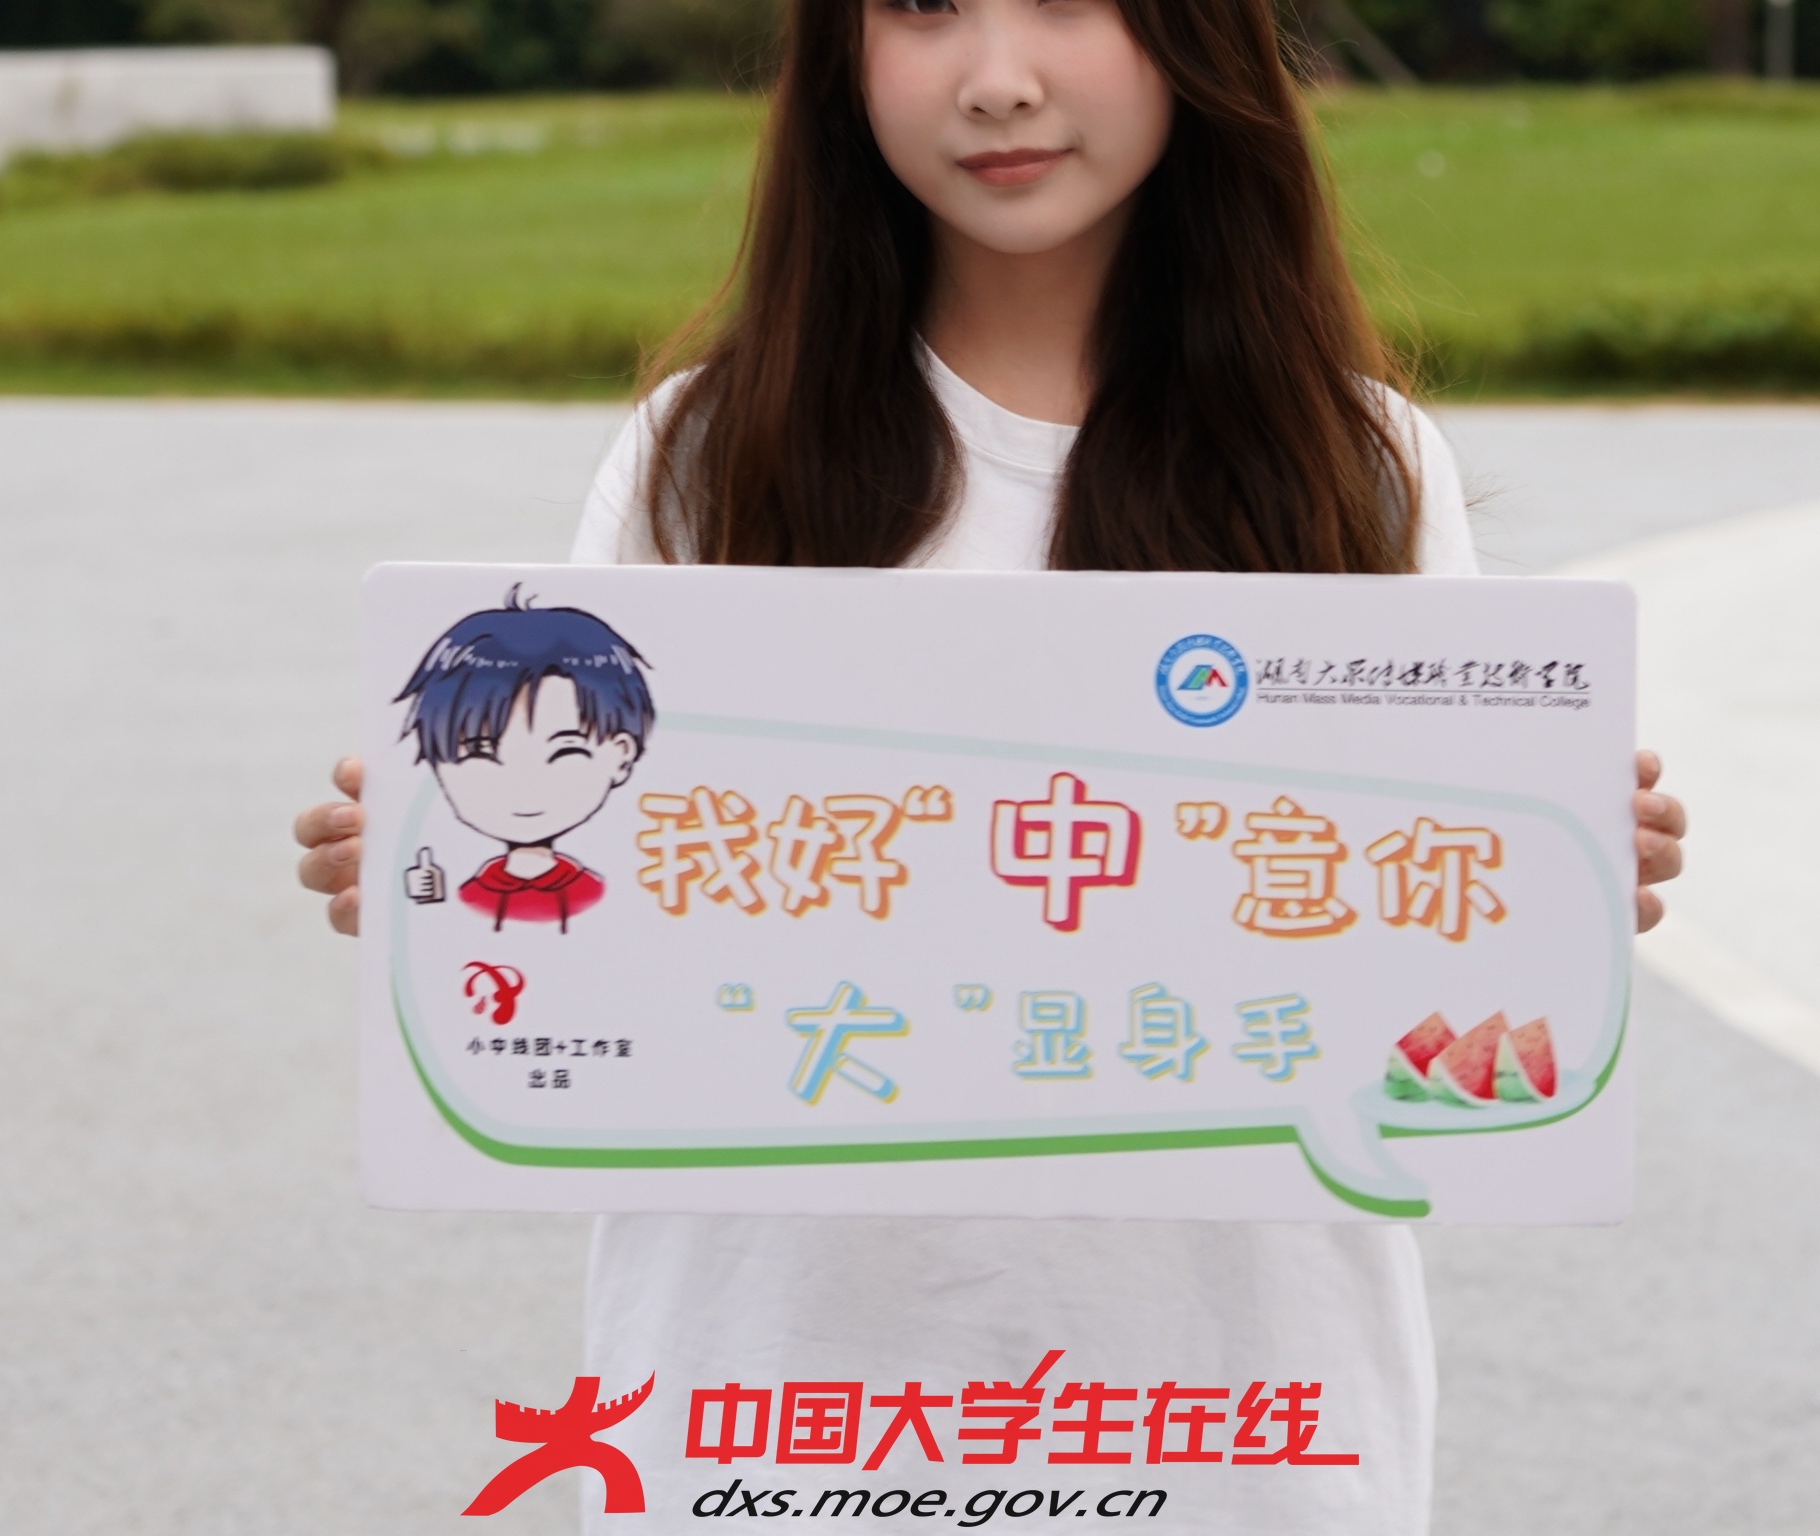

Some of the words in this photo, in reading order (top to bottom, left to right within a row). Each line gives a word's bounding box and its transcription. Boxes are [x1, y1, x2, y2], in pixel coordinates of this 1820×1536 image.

[1257, 693, 1297, 704] Hunan
[1303, 694, 1336, 705] Mass
[1341, 694, 1380, 705] Media
[1384, 694, 1453, 706] Vocational
[1458, 695, 1468, 706] &
[1473, 695, 1534, 707] Technical
[1539, 695, 1590, 710] College
[528, 1069, 571, 1089] 出品
